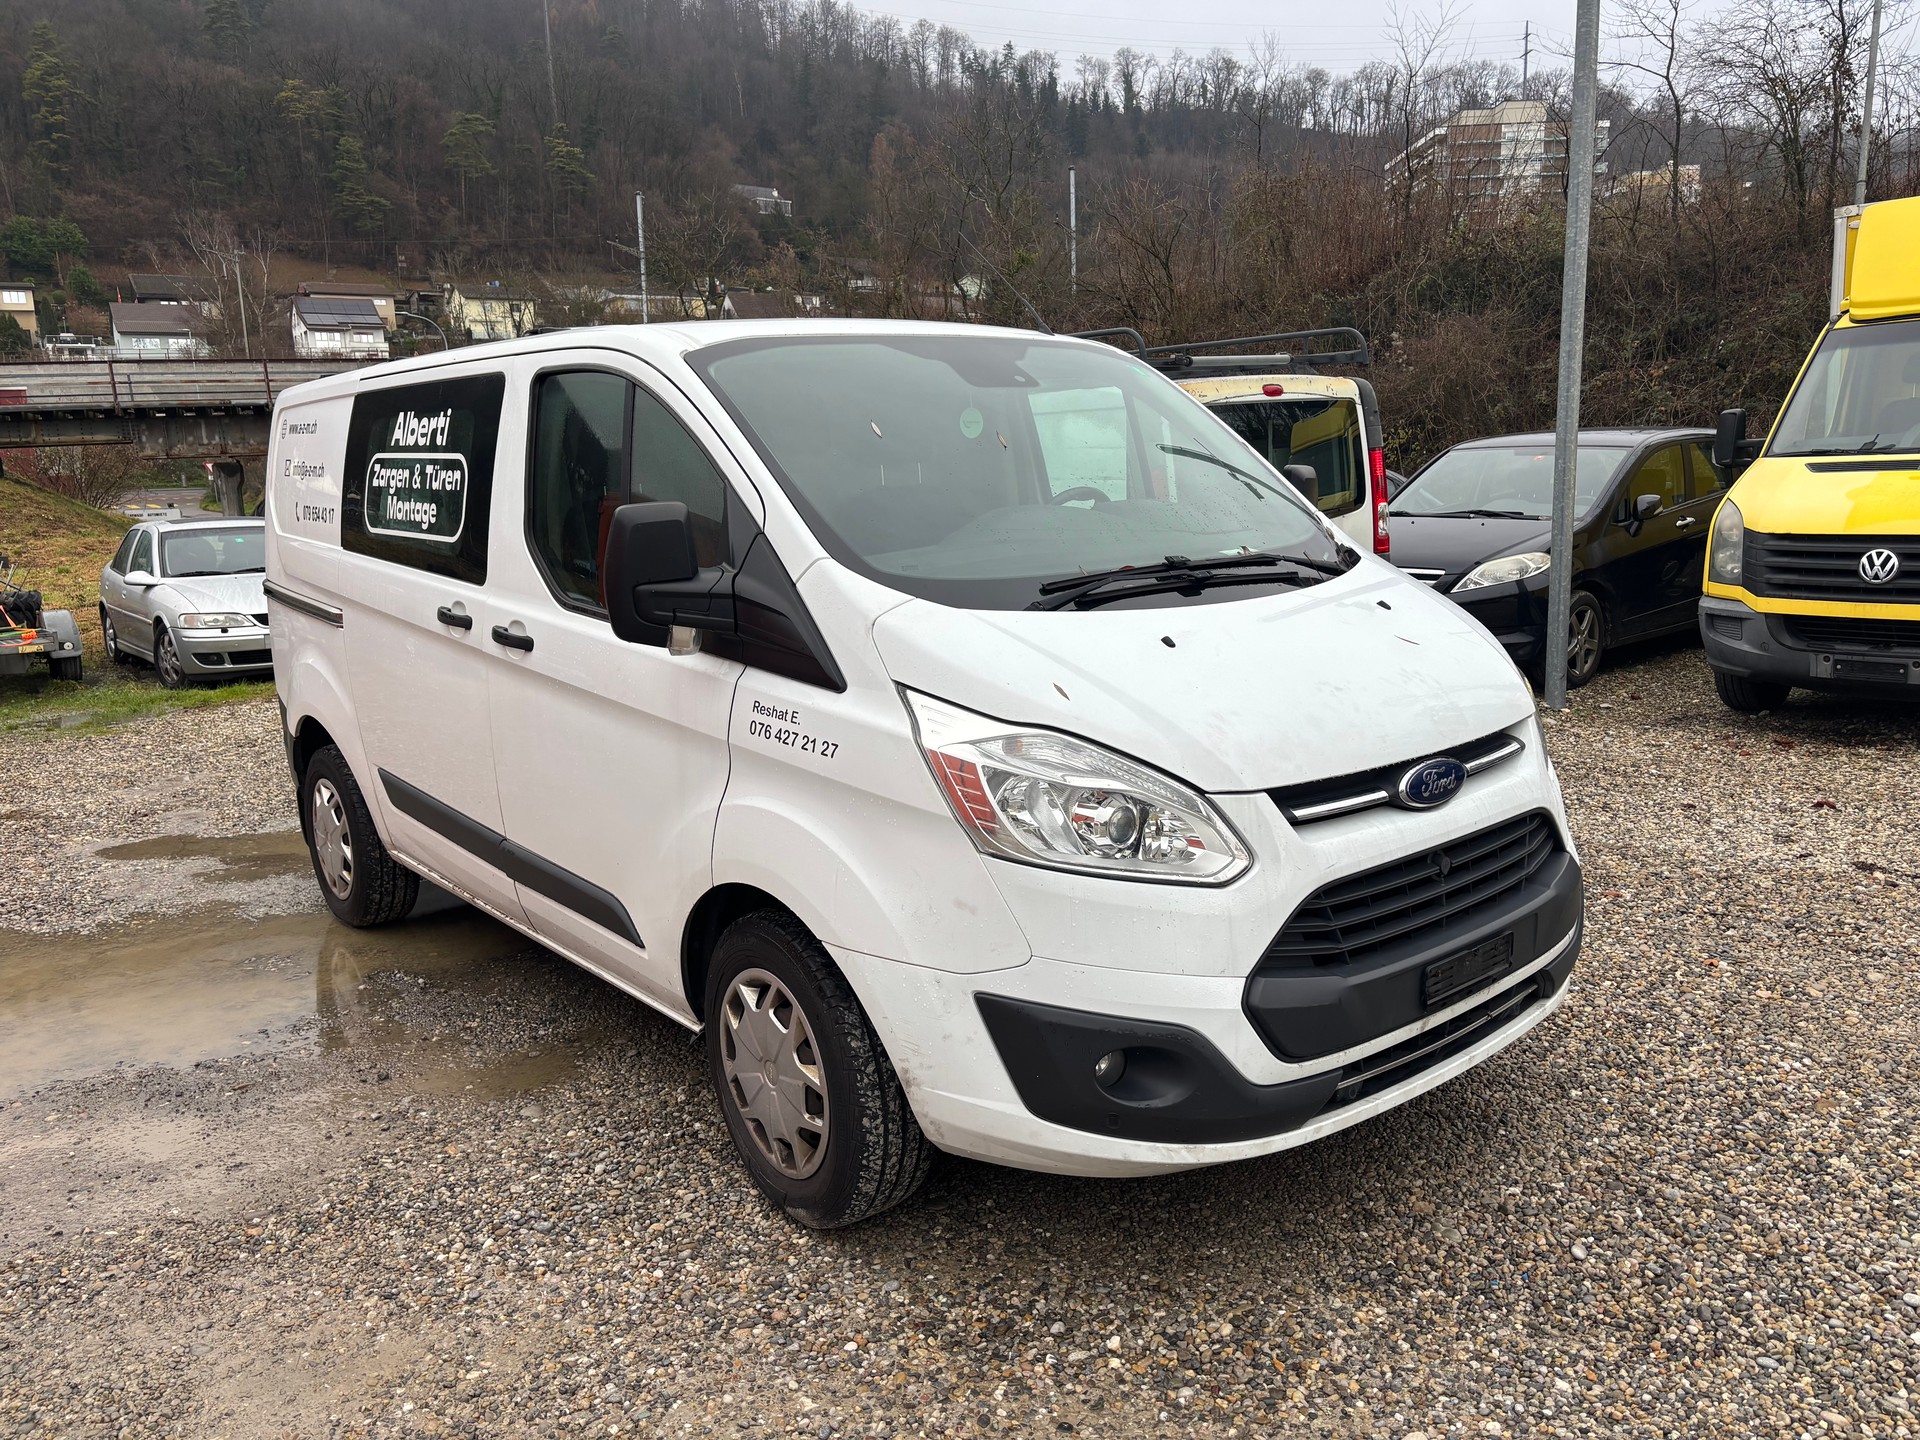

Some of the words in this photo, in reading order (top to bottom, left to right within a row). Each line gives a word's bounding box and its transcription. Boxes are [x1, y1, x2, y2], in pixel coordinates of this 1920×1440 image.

[391, 408, 452, 446] Alberti
[372, 464, 410, 494] Zargen
[412, 463, 421, 489] &
[425, 465, 461, 491] Türen
[303, 505, 311, 521] 079
[312, 506, 320, 523] 654
[321, 507, 328, 524] 43
[329, 508, 335, 525] 17
[387, 495, 437, 530] Montage
[752, 700, 788, 722] Reshat
[790, 711, 801, 726] E.
[749, 720, 772, 740] 076
[774, 727, 799, 747] 427
[801, 735, 817, 753] 21
[820, 741, 839, 759] 27
[1421, 766, 1457, 797] Ford
